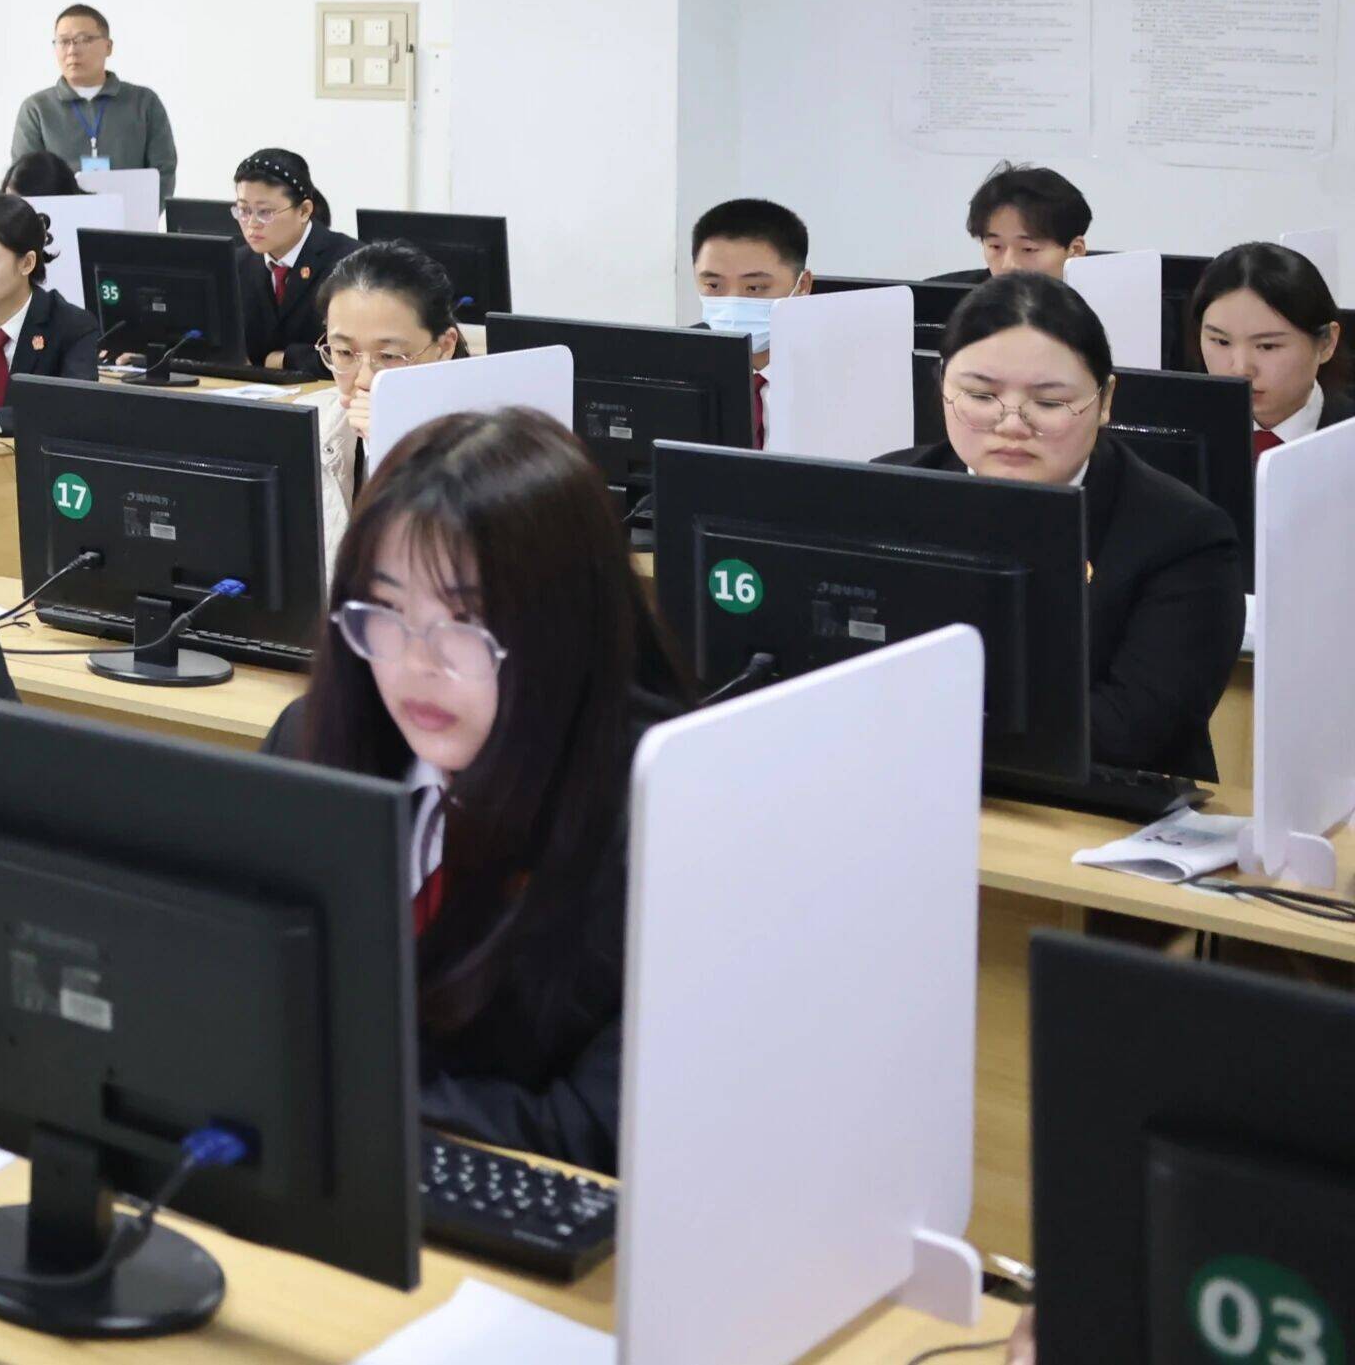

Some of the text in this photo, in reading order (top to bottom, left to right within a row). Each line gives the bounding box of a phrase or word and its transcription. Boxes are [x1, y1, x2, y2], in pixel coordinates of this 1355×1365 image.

[102, 284, 120, 301] 35
[57, 482, 87, 511] 17
[713, 570, 757, 604] 16
[1197, 1275, 1328, 1365] 03
